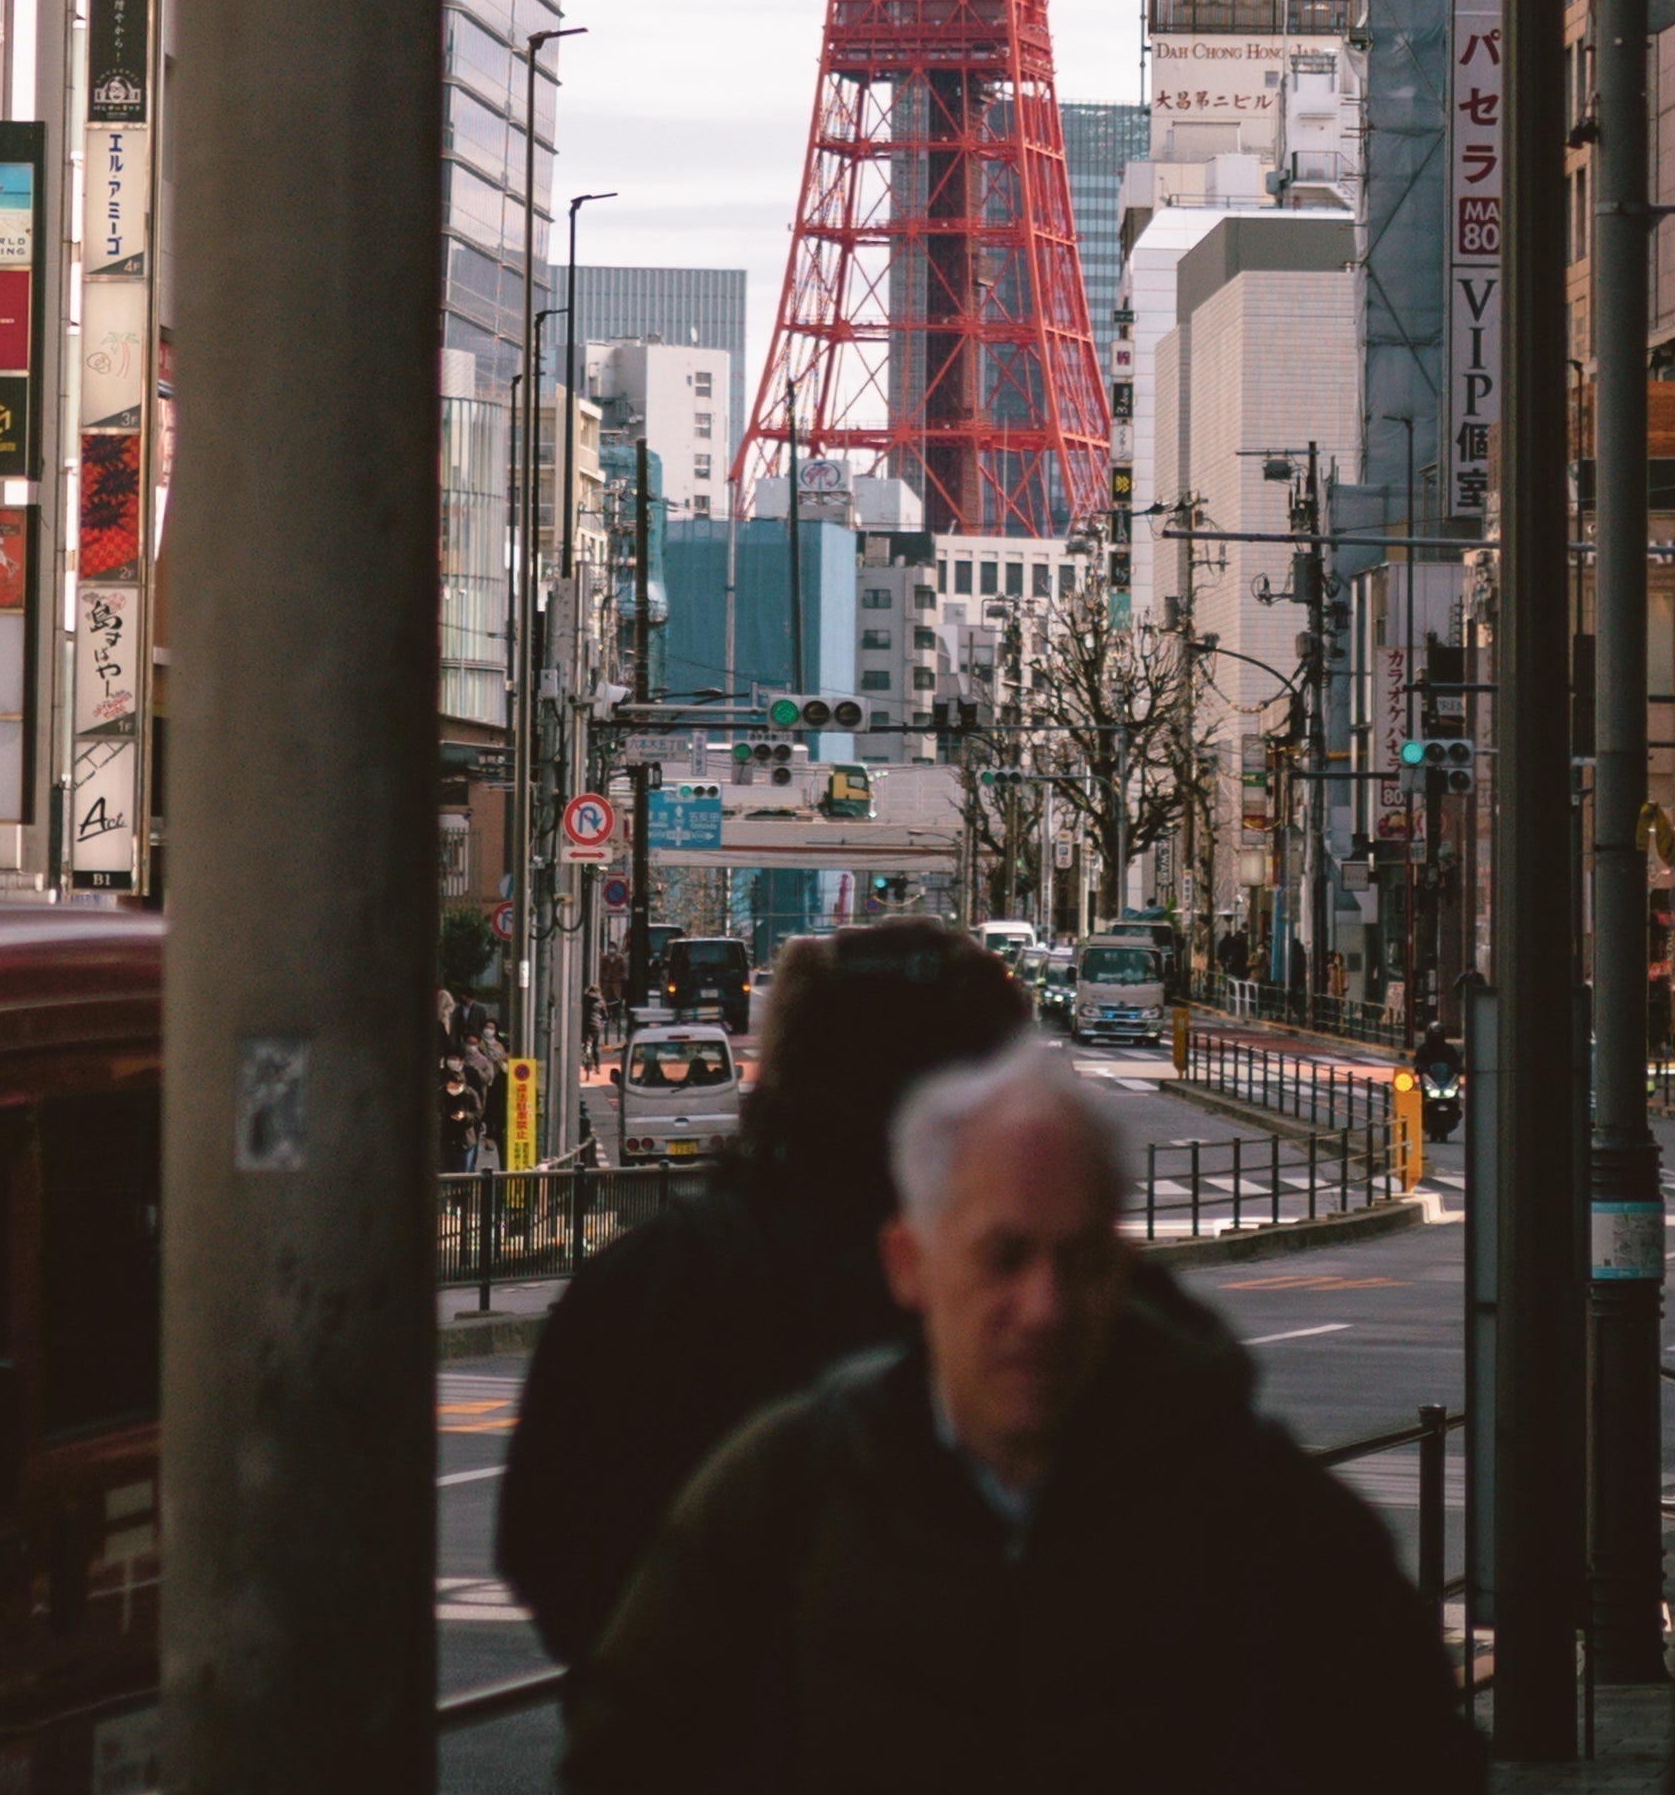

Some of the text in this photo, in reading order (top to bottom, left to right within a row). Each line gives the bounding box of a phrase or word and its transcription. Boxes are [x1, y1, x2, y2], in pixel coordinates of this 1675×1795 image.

[1156, 42, 1189, 61] DAH
[1192, 42, 1243, 61] CHONG
[1246, 42, 1285, 61] HONG
[1156, 90, 1273, 111] 大昌第二ビル
[1464, 202, 1500, 222] MA
[1463, 224, 1500, 252] 80
[92, 873, 111, 887] B1
